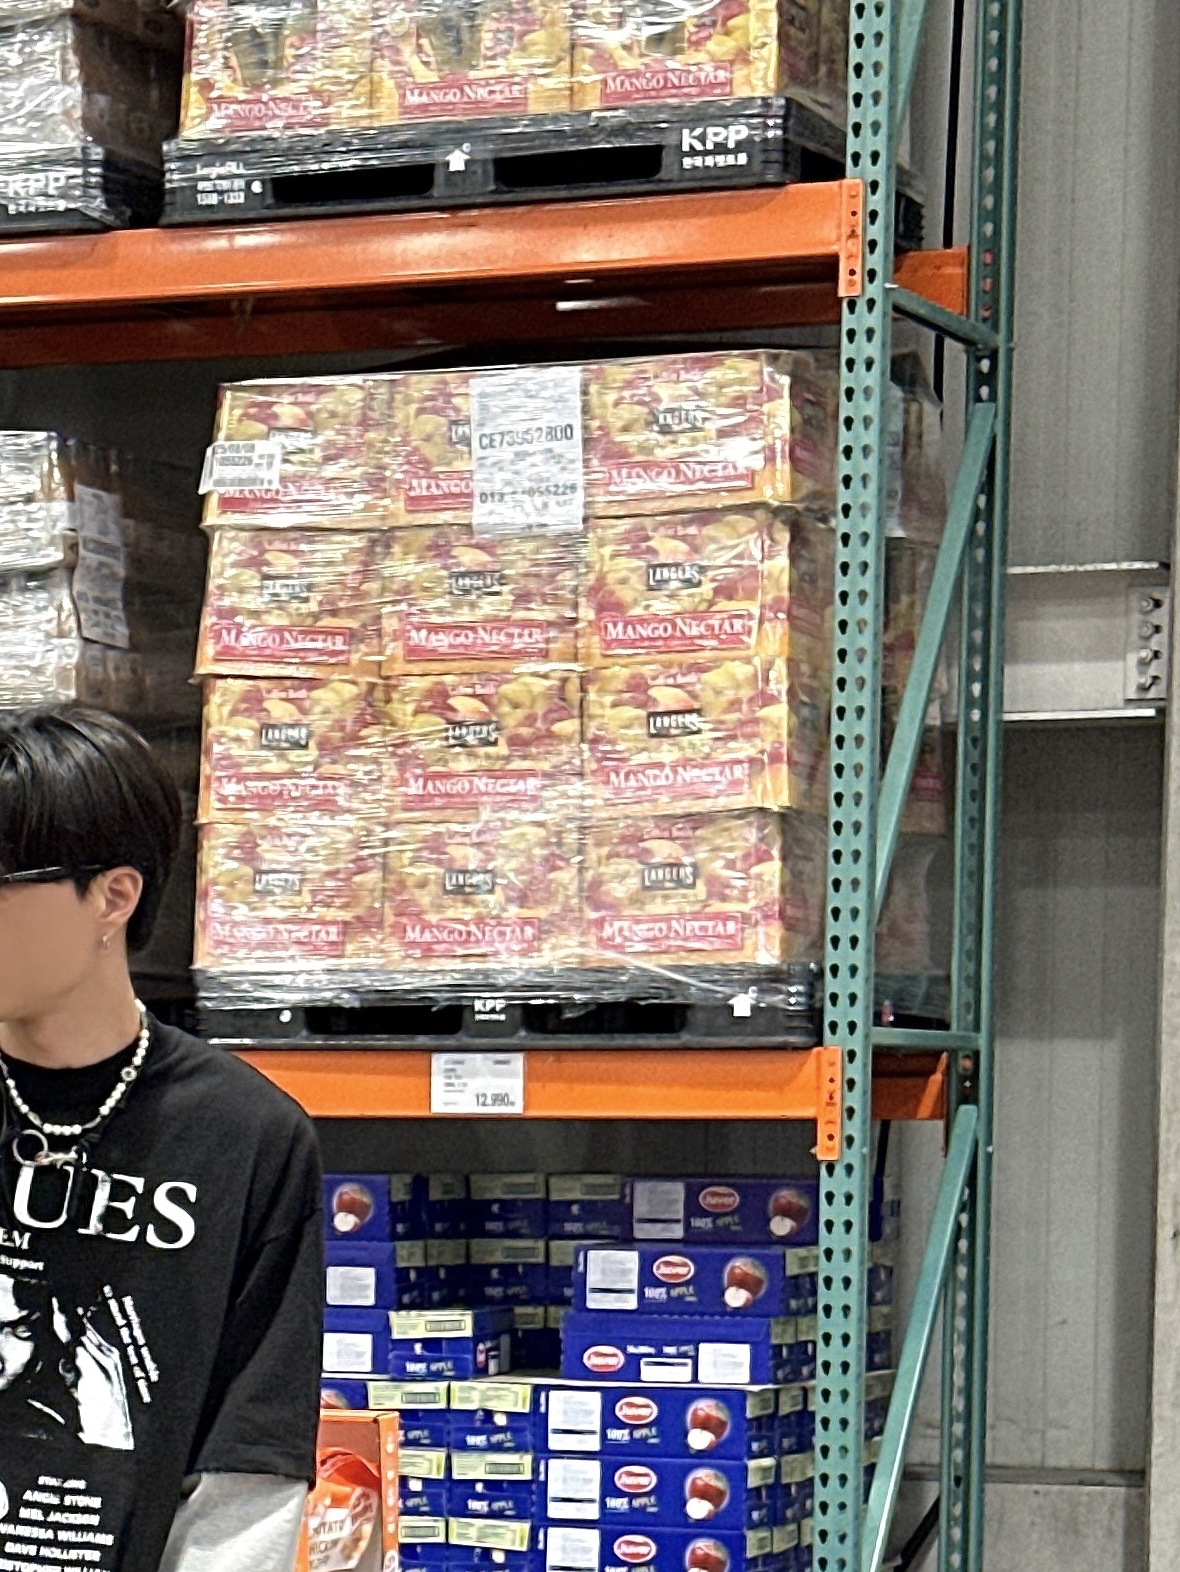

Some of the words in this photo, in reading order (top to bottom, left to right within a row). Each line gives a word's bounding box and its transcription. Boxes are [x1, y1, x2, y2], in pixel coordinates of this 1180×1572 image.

[606, 73, 664, 94] MANGO
[667, 65, 729, 88] NECTAR
[681, 125, 749, 151] KPP
[606, 622, 672, 641] MANGO
[676, 618, 747, 638] NECTAR
[408, 776, 469, 796] MANGO
[404, 923, 469, 943] MANGO
[472, 922, 536, 942] NECTAR
[0, 1253, 44, 1271] support
[63, 1494, 102, 1509] STONE
